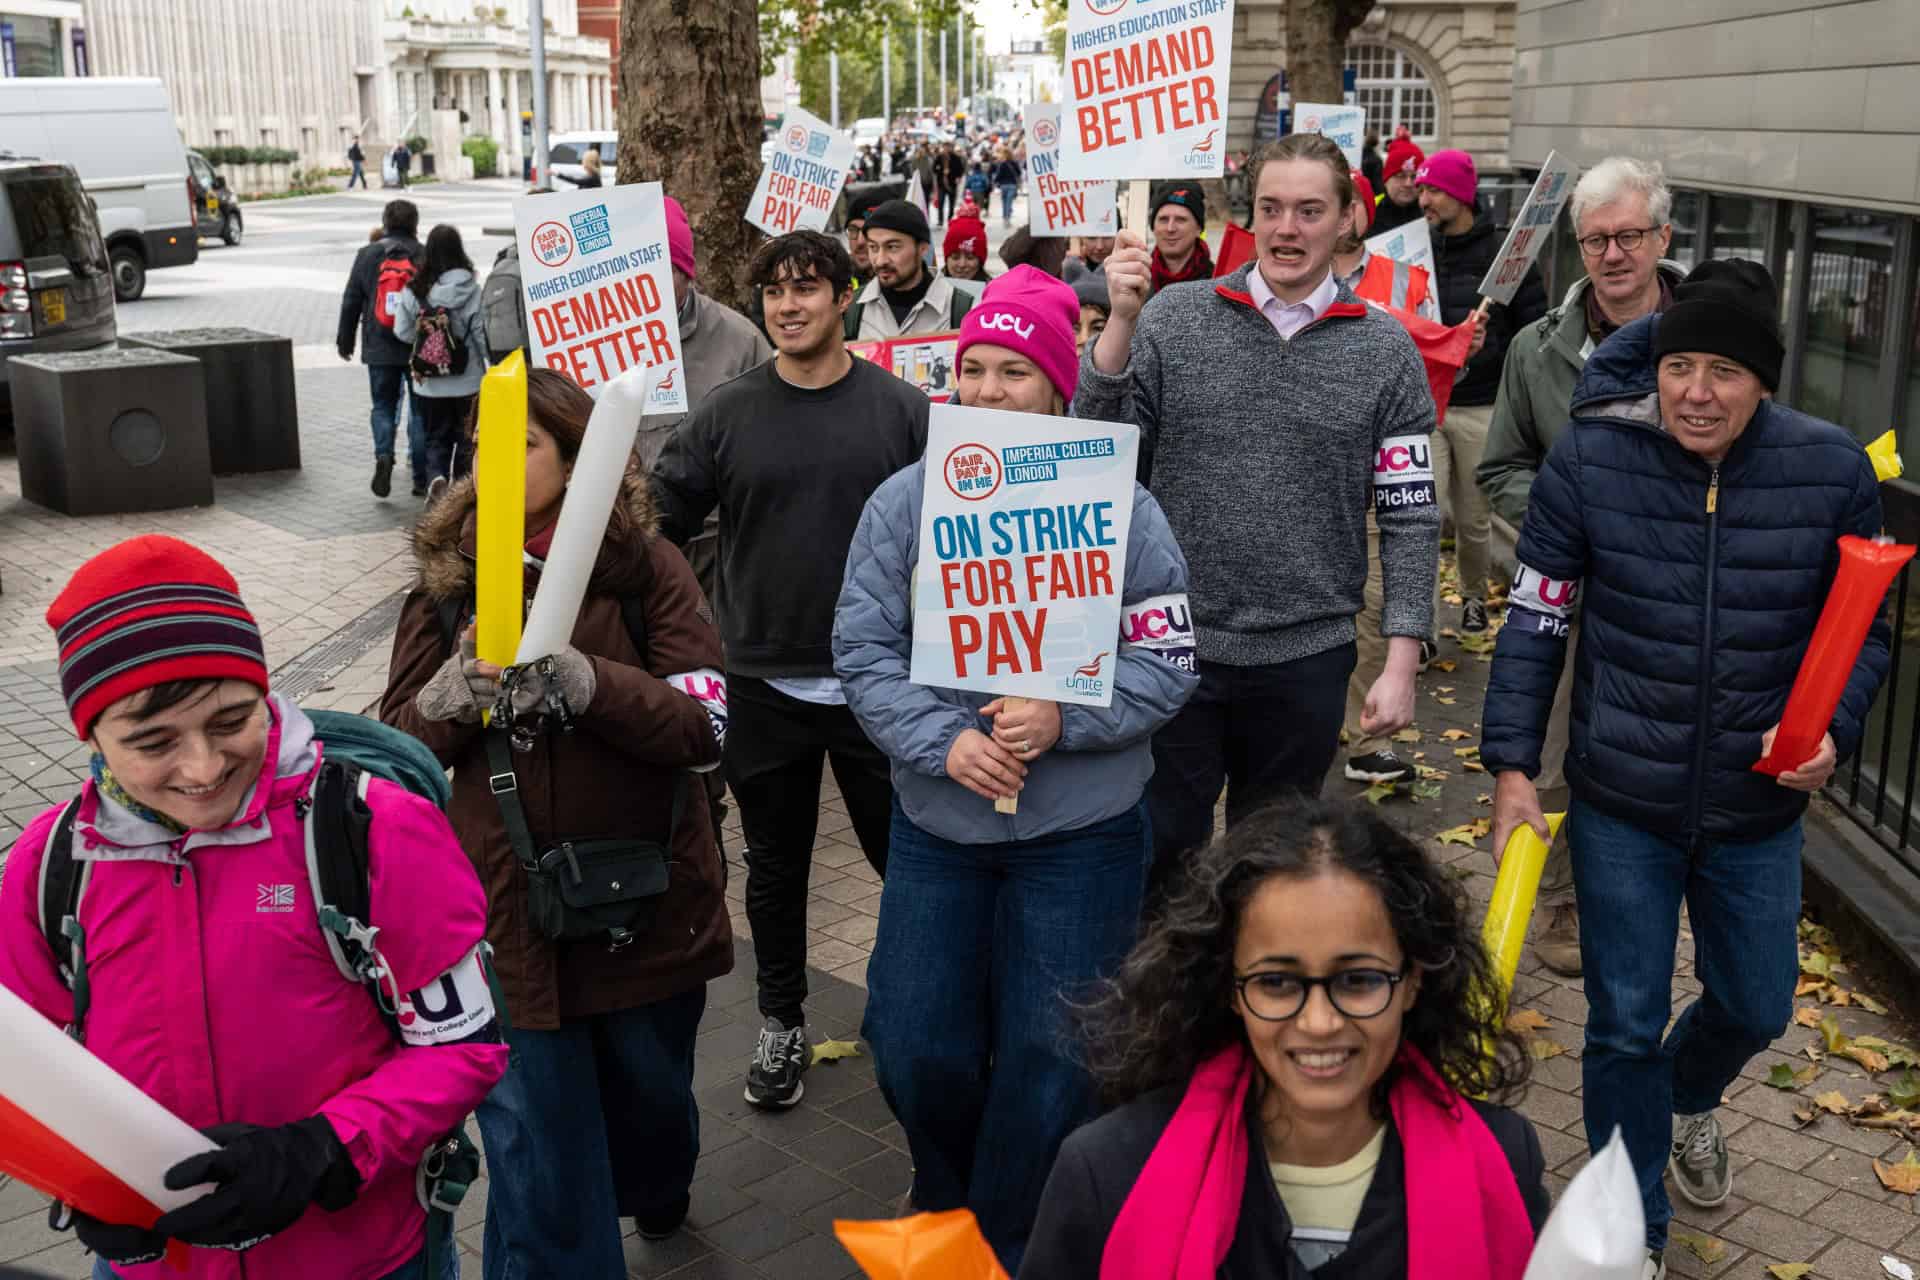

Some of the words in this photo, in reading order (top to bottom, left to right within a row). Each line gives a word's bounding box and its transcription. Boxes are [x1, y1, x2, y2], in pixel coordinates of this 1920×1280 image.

[1072, 24, 1117, 51] HIGHER
[1119, 7, 1188, 38] EDUCATION
[1189, 0, 1227, 19] STAFF
[1071, 26, 1216, 100] DEMAND
[1077, 76, 1220, 153] BETTER
[772, 151, 792, 175] ON
[792, 158, 840, 190] STRIKE
[1031, 151, 1054, 175] ON
[768, 172, 797, 199] FOR
[798, 182, 832, 211] FAIR
[574, 220, 608, 240] COLLEGE
[762, 196, 802, 233] PAY
[1044, 192, 1086, 231] PAY
[579, 235, 611, 253] LONDON
[528, 278, 570, 302] HIGHER
[569, 257, 631, 288] EDUCATION
[630, 243, 662, 272] STAFF
[532, 273, 661, 347] DEMAND
[953, 453, 983, 468] FAIR
[1005, 444, 1061, 464] IMPERIAL
[1062, 439, 1113, 458] COLLEGE
[955, 465, 980, 480] PAY
[957, 479, 973, 492] IN
[975, 476, 993, 488] HE
[1008, 464, 1054, 483] LONDON
[1376, 486, 1432, 506] Picket
[933, 513, 984, 561] ON
[989, 501, 1117, 556] STRIKE
[940, 559, 1016, 609] FOR
[1024, 550, 1115, 602] FAIR
[948, 608, 1048, 678] PAY
[1538, 615, 1569, 637] Pic
